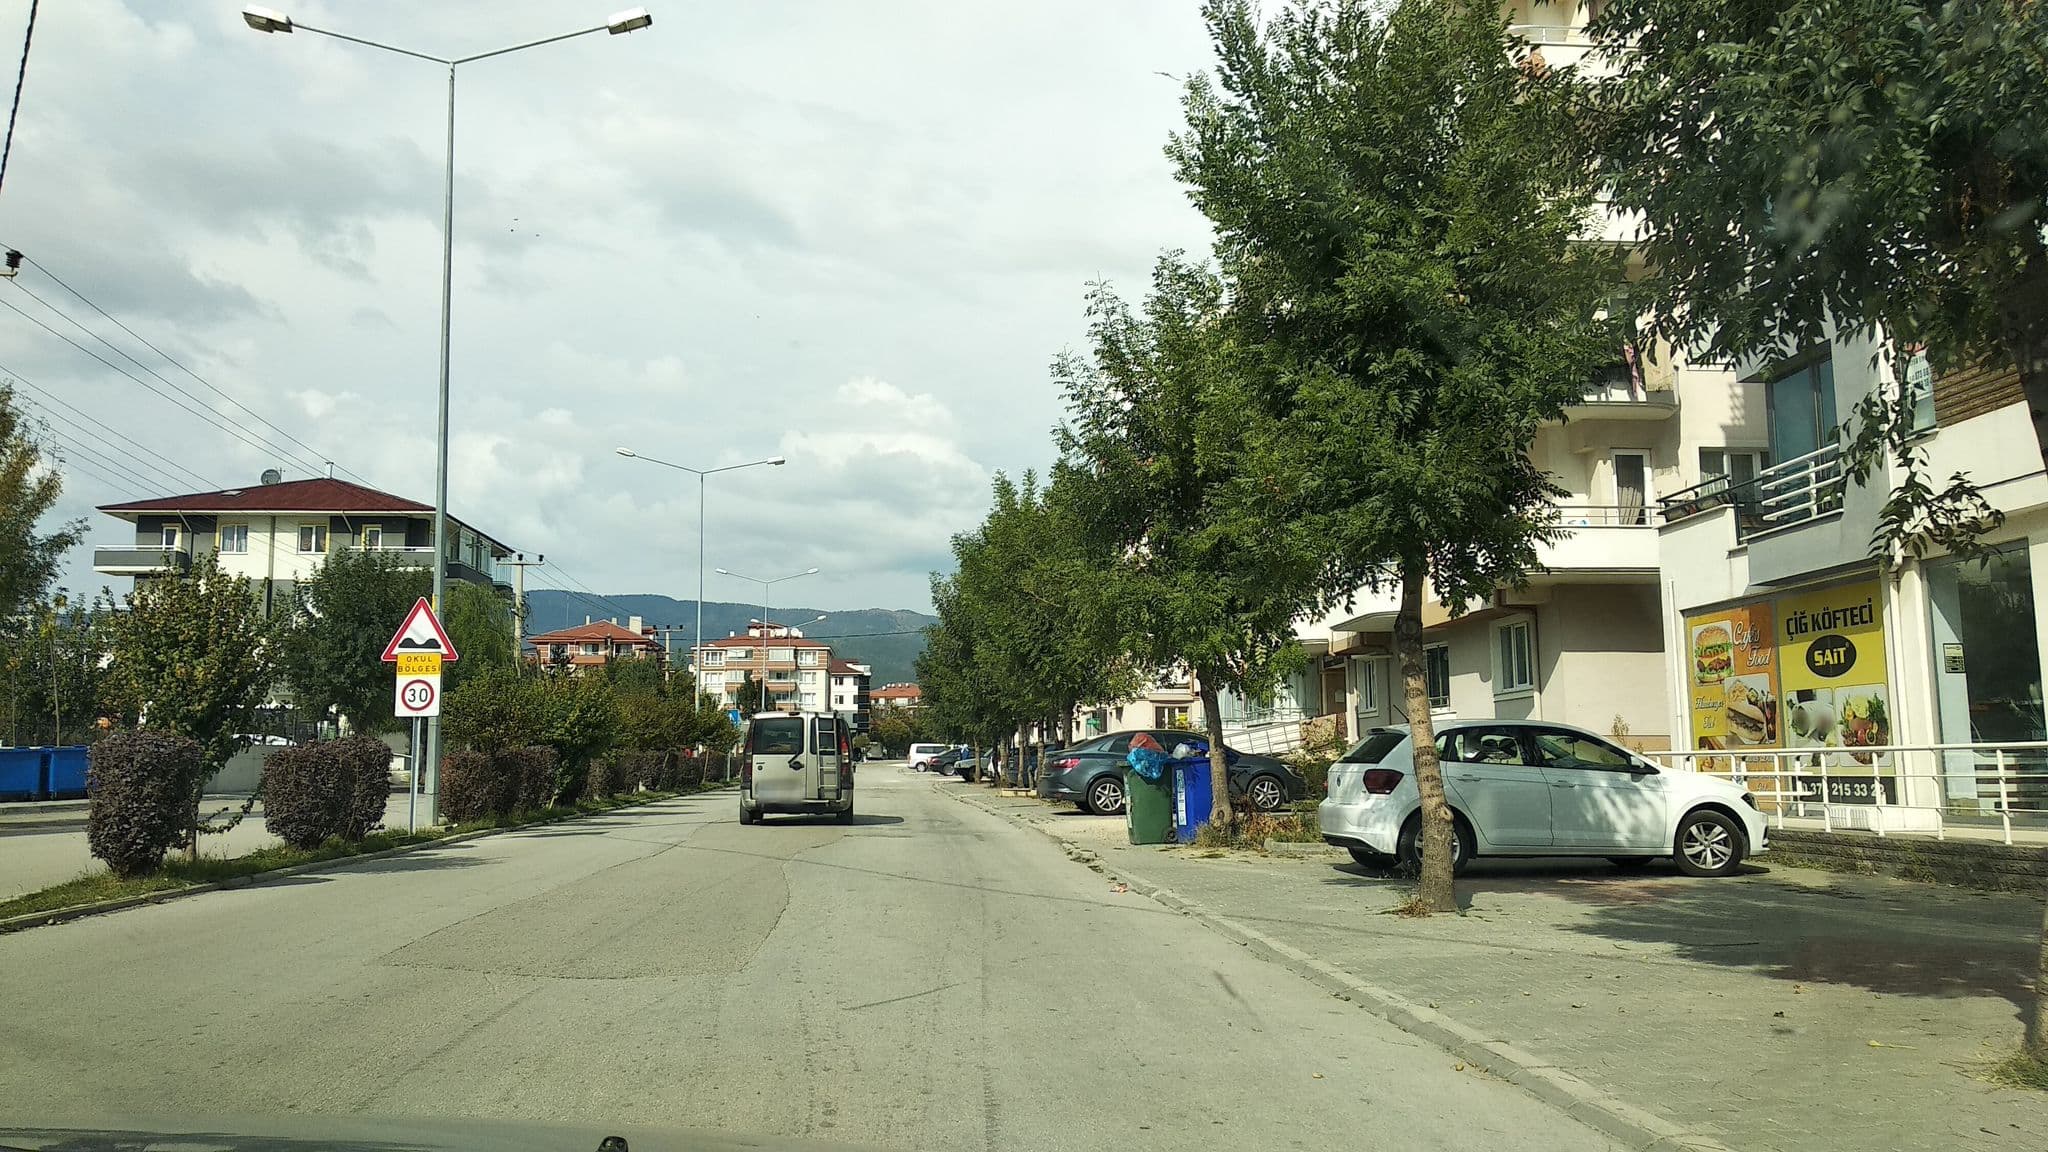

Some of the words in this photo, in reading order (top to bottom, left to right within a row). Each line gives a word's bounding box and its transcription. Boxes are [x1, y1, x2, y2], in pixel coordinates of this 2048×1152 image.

[1786, 610, 1808, 641] ÇİĞ
[1811, 597, 1874, 632] KÖFTECİ
[399, 664, 440, 672] BÖLGESİ
[408, 688, 428, 702] 30
[1810, 782, 1828, 796] 37
[1831, 782, 1851, 797] 215
[1854, 783, 1868, 797] 33
